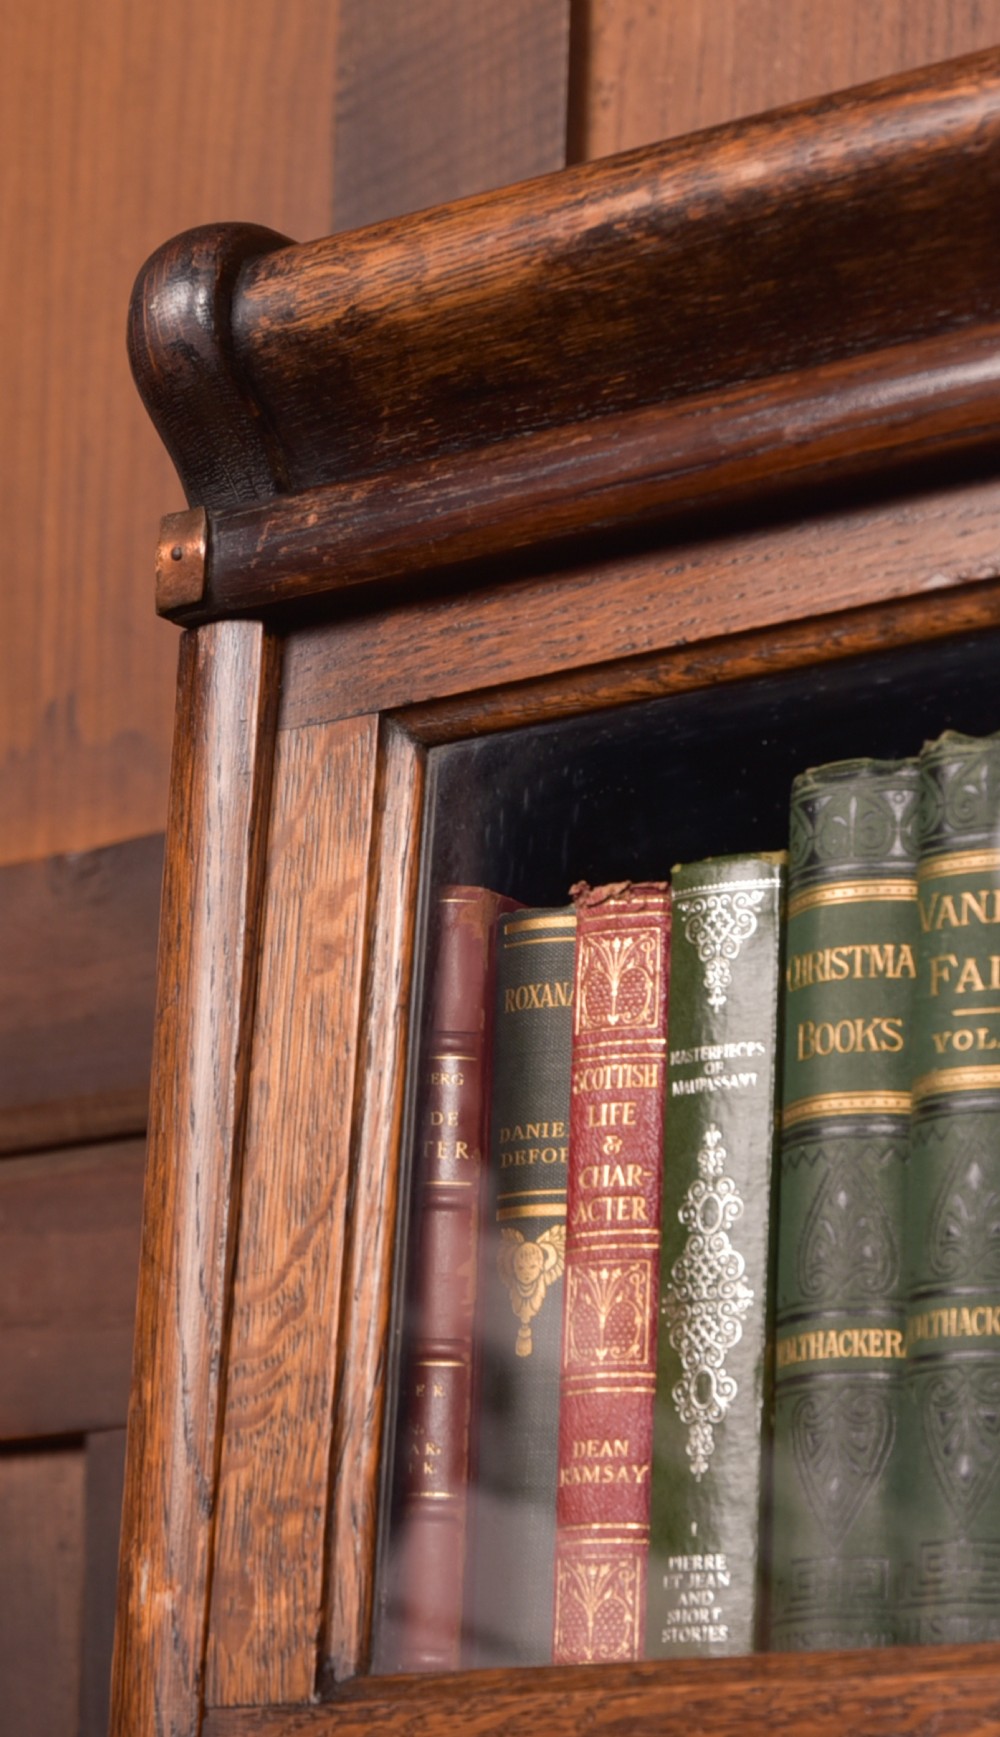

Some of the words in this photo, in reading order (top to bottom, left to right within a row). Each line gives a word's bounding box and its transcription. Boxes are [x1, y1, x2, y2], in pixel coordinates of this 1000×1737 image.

[797, 1017, 904, 1062] BOOKS
[572, 1063, 659, 1095] SCOTTISH
[703, 1060, 724, 1075] OF
[588, 1101, 637, 1128] LIFE
[602, 1134, 623, 1156] &
[578, 1163, 652, 1190] CHAR-
[572, 1195, 648, 1226] ACTER
[573, 1439, 629, 1459] DEAN
[559, 1464, 650, 1488] RAMSAY
[679, 1589, 715, 1607] AND
[661, 1624, 729, 1644] STORIES
